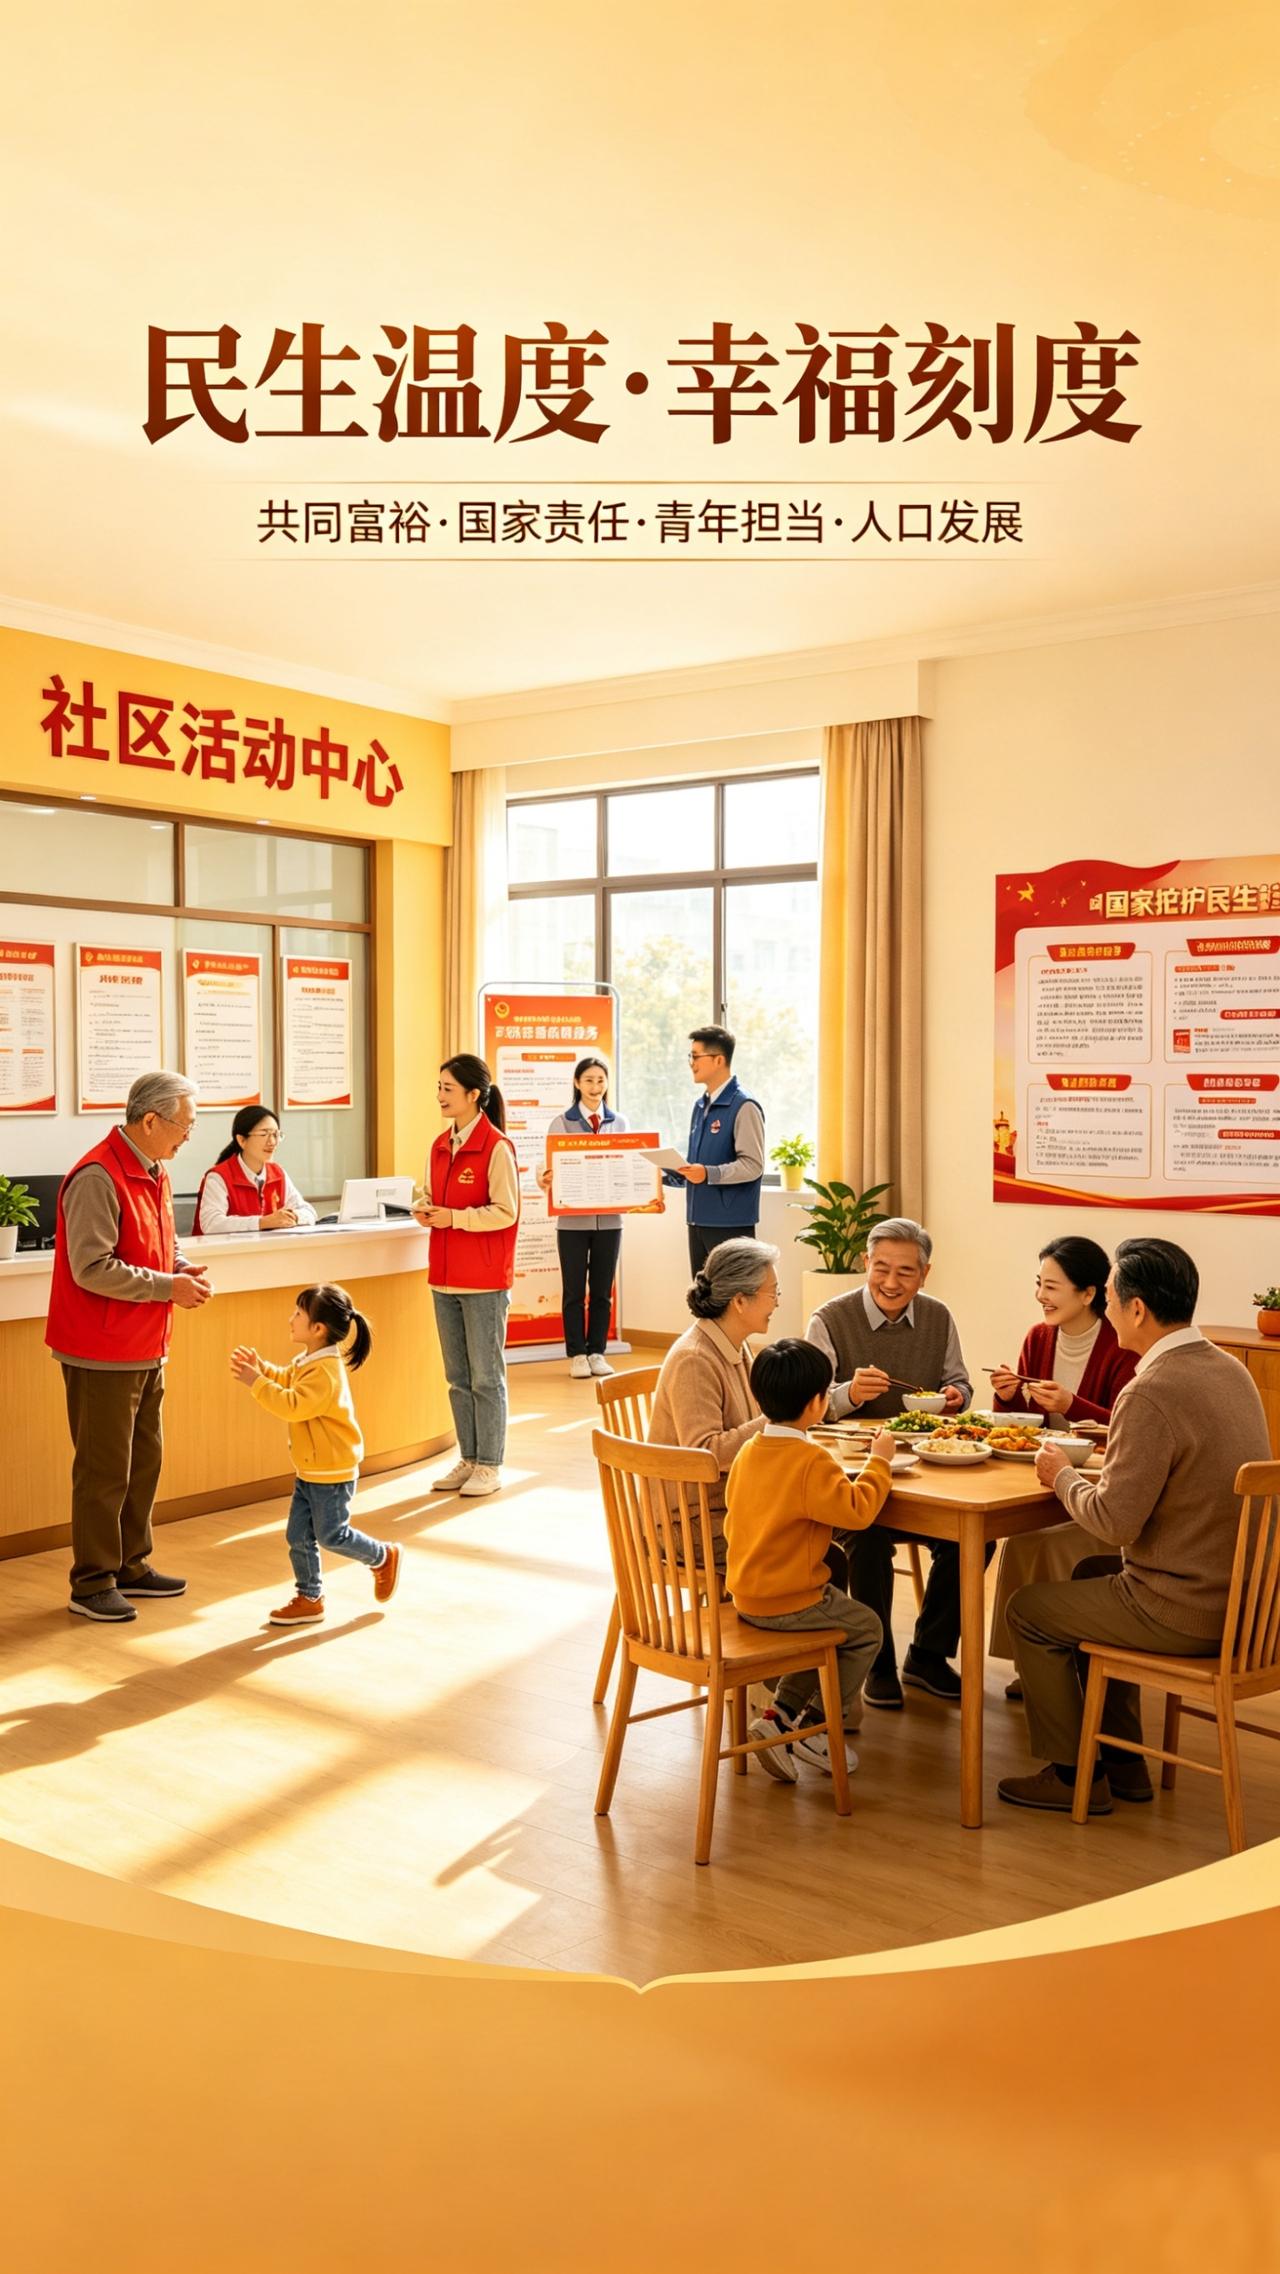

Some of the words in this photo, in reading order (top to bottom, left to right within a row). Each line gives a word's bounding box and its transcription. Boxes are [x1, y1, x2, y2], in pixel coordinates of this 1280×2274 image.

[40, 674, 404, 808] 社区活动中心
